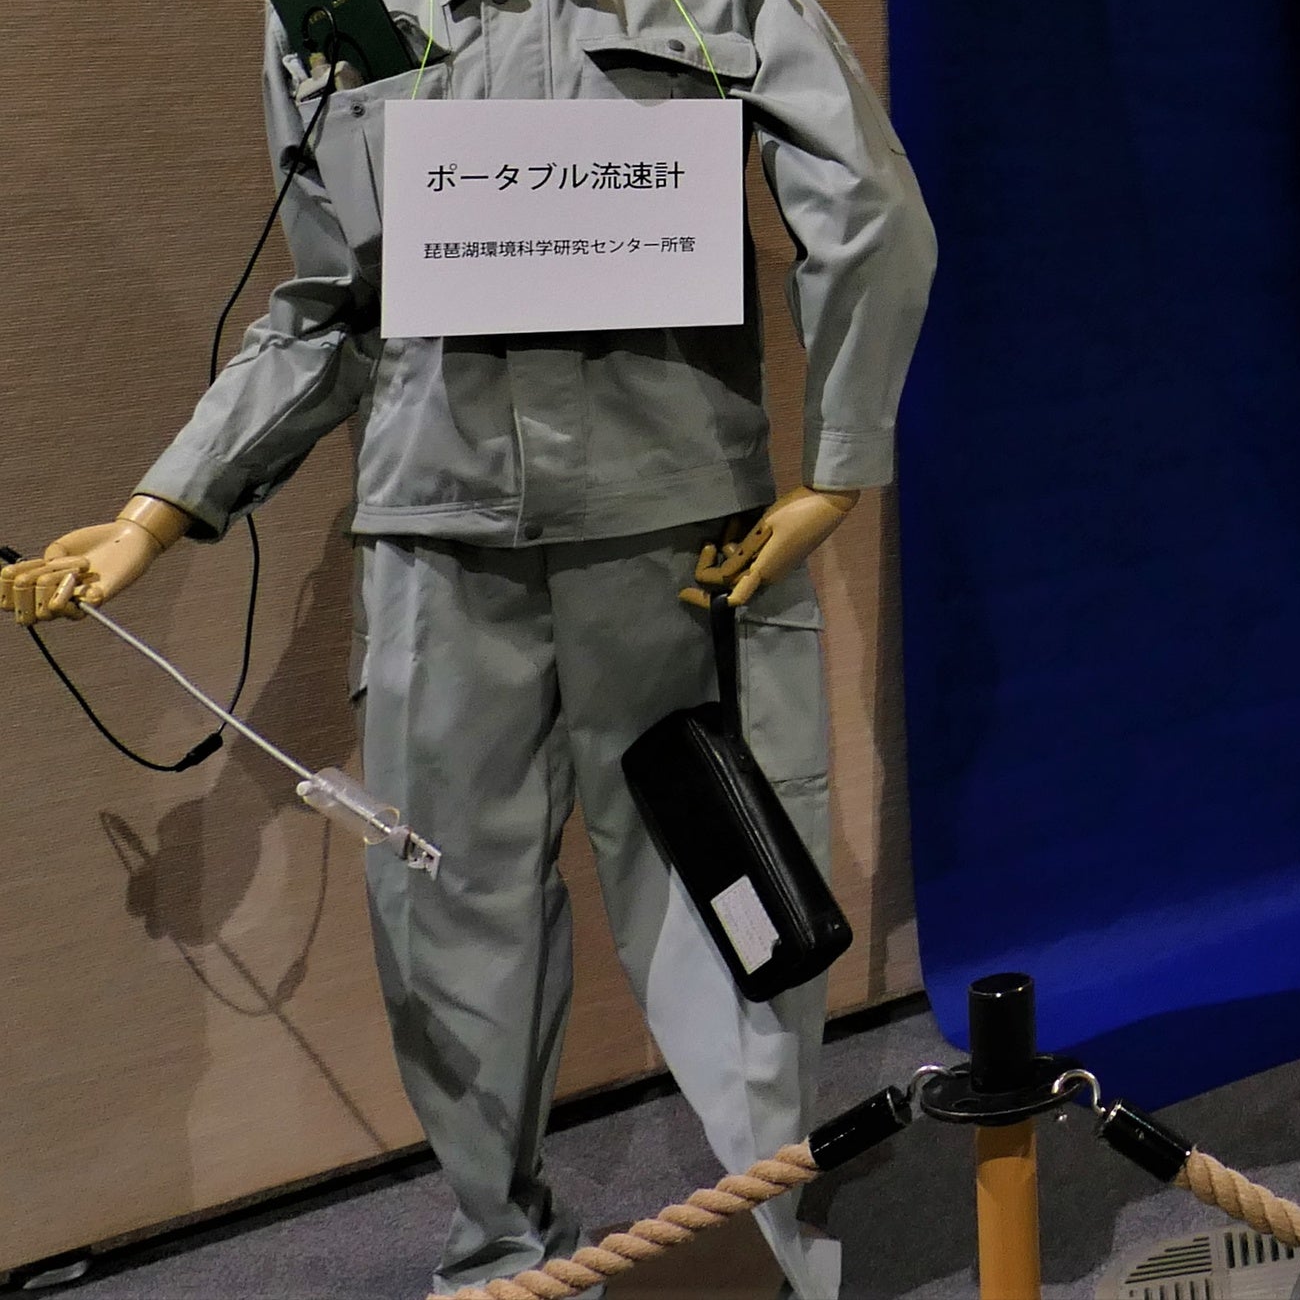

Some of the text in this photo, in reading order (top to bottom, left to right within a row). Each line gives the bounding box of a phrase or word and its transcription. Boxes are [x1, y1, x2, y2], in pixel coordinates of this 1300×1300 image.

[426, 161, 685, 192] ポータブル流速計
[423, 237, 697, 259] 琵琶湖環境科学研究センター所管
